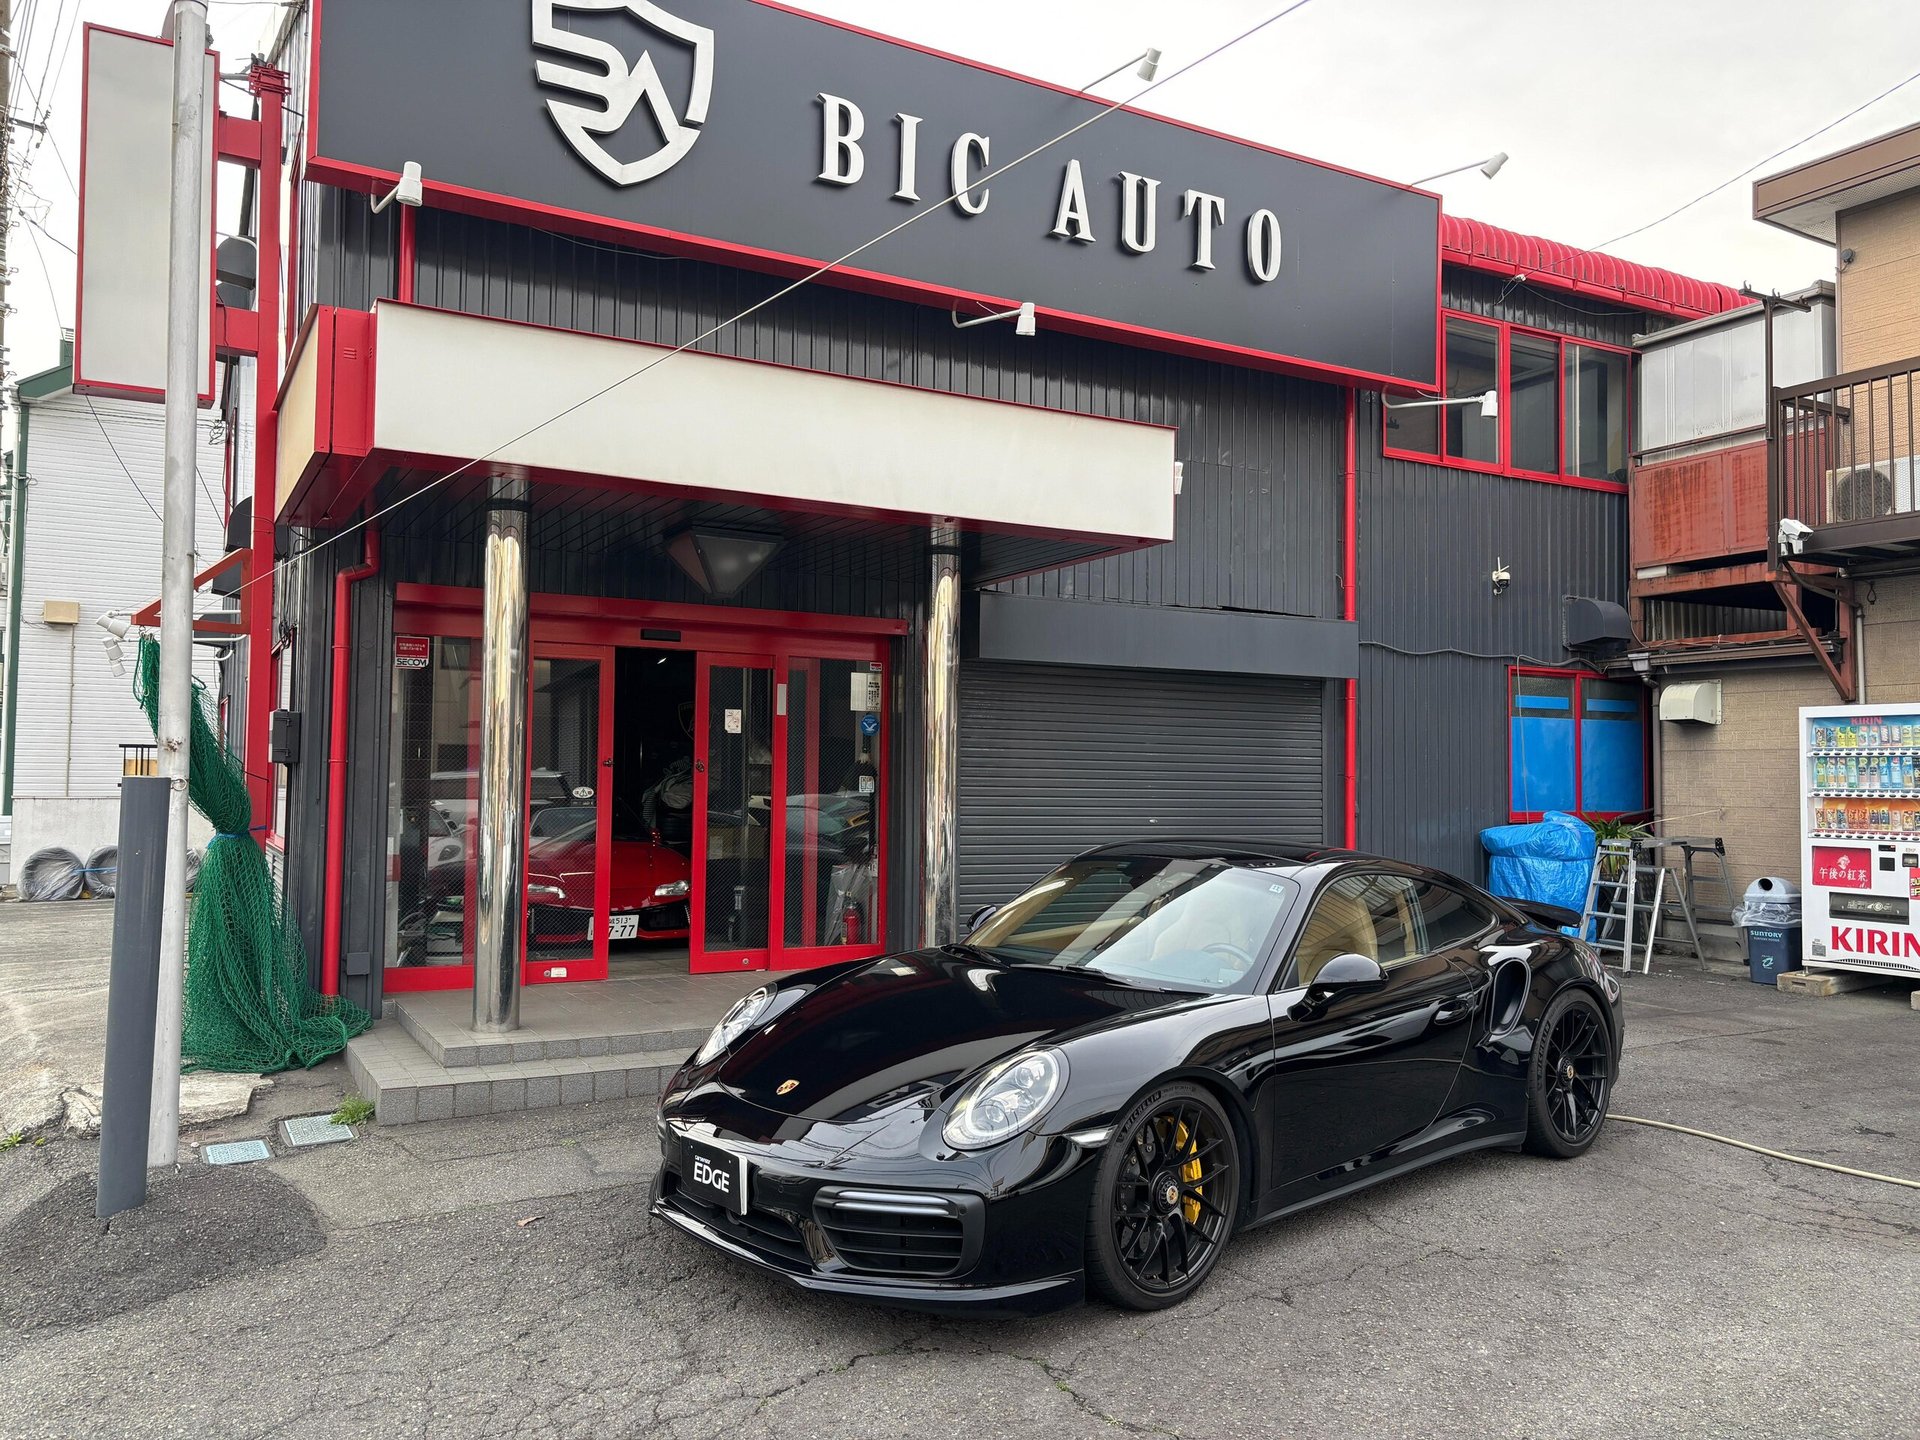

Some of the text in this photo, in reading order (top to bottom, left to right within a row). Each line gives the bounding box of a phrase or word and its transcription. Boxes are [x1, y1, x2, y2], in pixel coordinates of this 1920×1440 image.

[816, 92, 1283, 283] BIC AUTO
[396, 657, 428, 667] SECOM
[1850, 716, 1883, 725] KIRIN
[1819, 867, 1868, 881] 午後の紅茶
[608, 925, 636, 937] 7-77
[1750, 930, 1783, 938] SUNTORY
[1124, 1091, 1162, 1133] MICHELIN
[693, 1161, 730, 1193] EDGE
